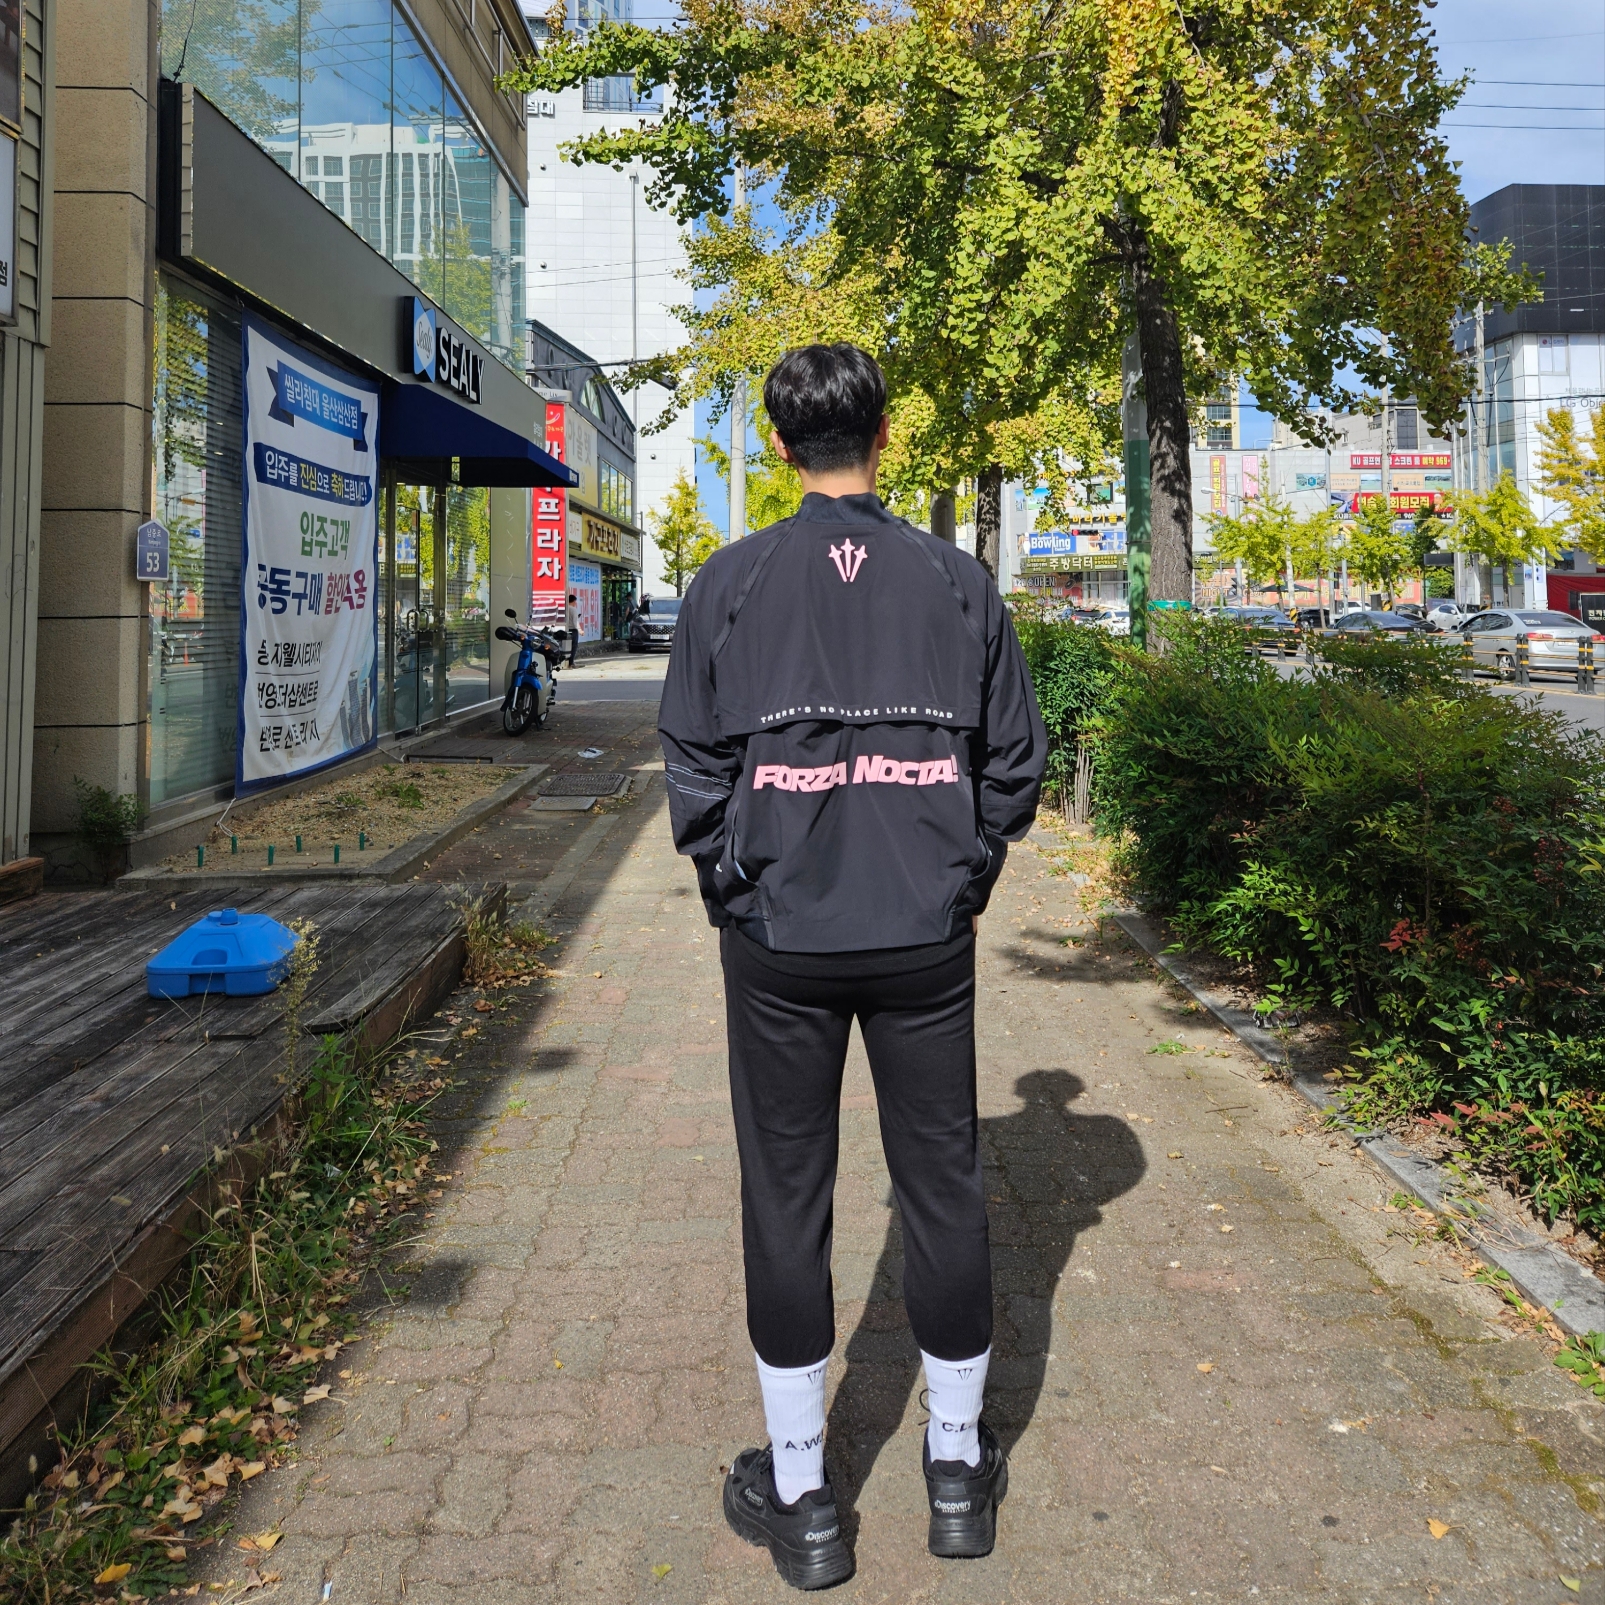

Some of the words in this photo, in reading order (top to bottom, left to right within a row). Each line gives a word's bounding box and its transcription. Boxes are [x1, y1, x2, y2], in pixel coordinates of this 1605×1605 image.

[439, 327, 485, 405] SEALY
[1363, 456, 1393, 466] 골프연
[265, 450, 298, 487] 입주를
[300, 463, 330, 494] 진심으로
[537, 441, 562, 581] 가프라자
[1390, 496, 1430, 510] 회원모집
[300, 511, 350, 560] 입주고객
[1031, 536, 1071, 551] Bowling
[146, 552, 160, 573] 53
[1049, 556, 1093, 571] 주방닥터
[760, 706, 812, 724] THERE'S
[820, 706, 835, 714] NO
[840, 708, 879, 717] PLACE
[886, 706, 917, 714] LIKE
[925, 707, 954, 719] ROAD
[753, 761, 848, 793] FORZA
[852, 754, 959, 786] NOCTA!
